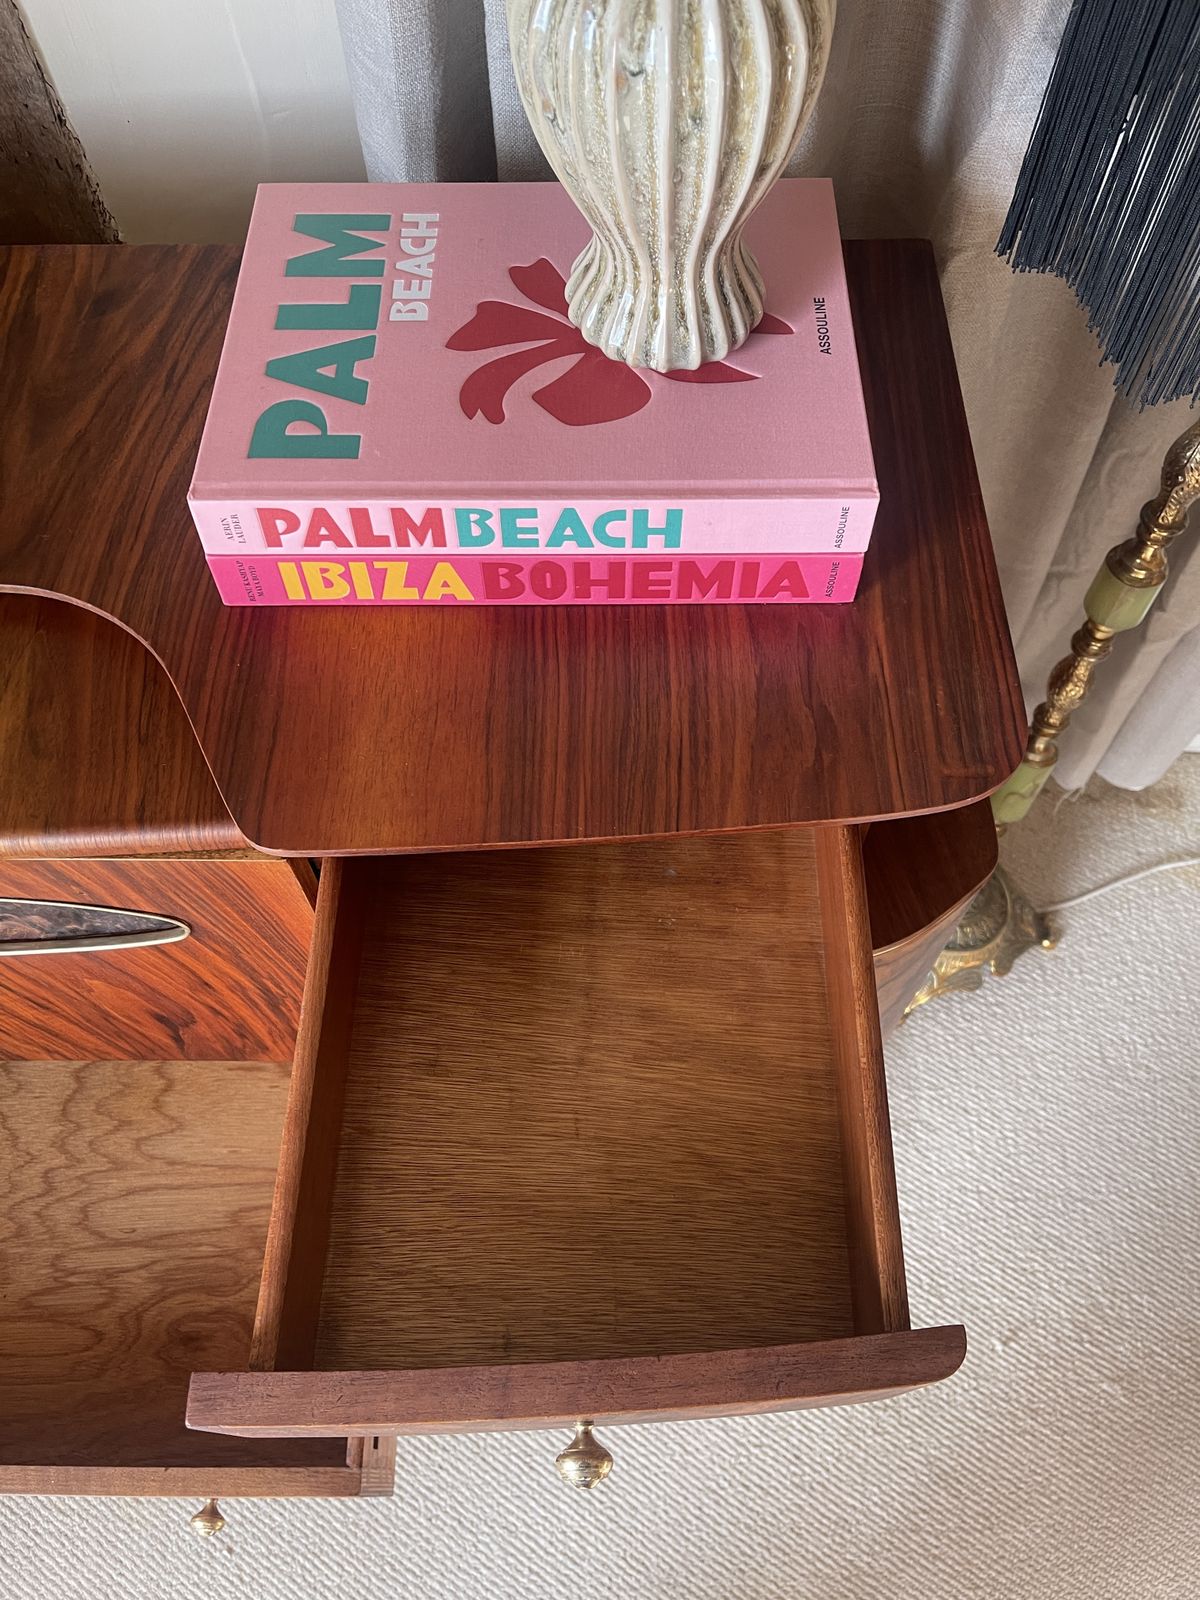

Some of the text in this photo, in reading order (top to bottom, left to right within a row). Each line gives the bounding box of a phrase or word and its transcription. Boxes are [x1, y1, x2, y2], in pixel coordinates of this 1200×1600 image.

[389, 213, 440, 322] BEACH
[248, 212, 392, 459] PALM
[813, 297, 832, 355] ASSOULINE
[220, 517, 235, 541] AERIN
[230, 514, 246, 544] LAUDER
[256, 507, 684, 548] PALM BEACH
[834, 506, 850, 549] ASSOULINE
[277, 560, 810, 601] IBIZA BOHEMIA
[825, 561, 840, 598] ASSOULINE
